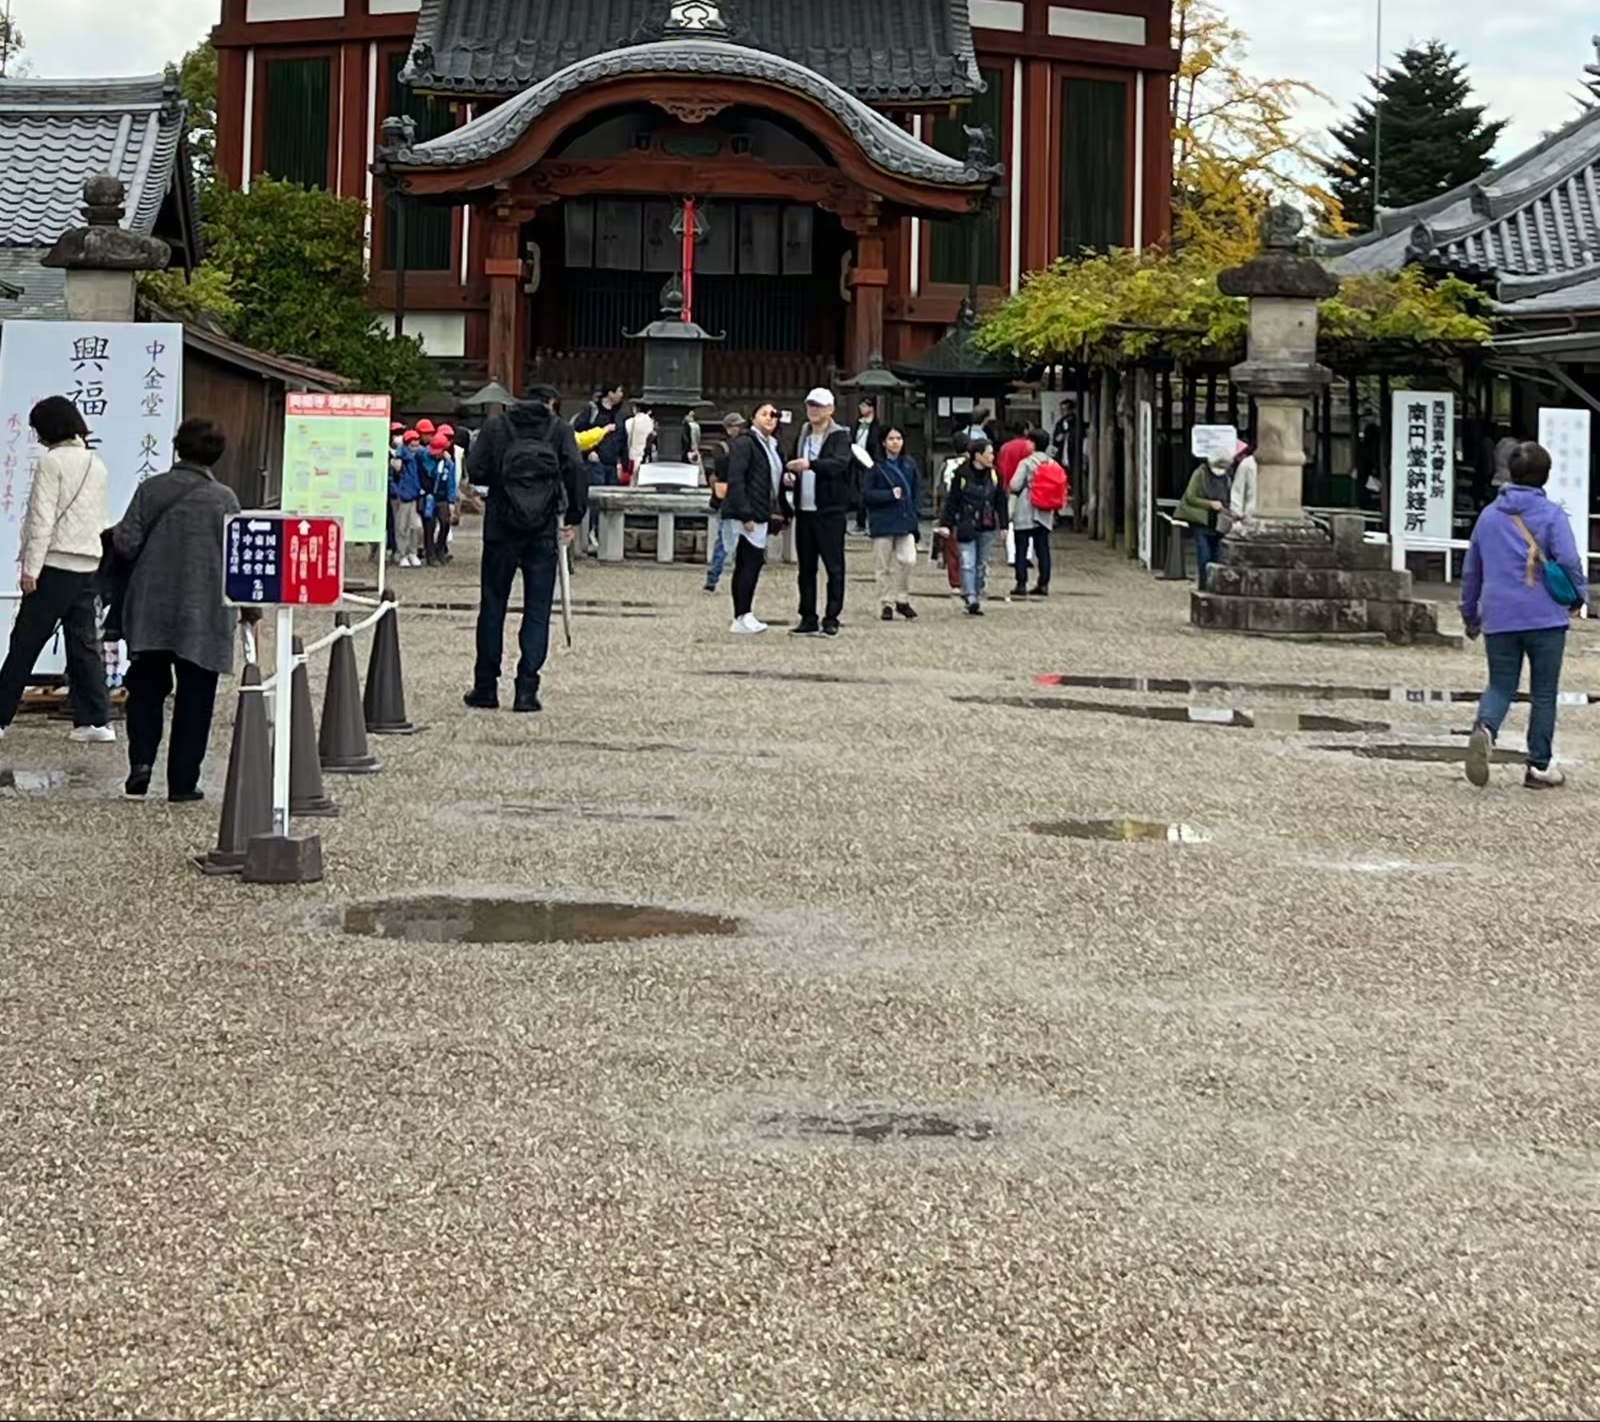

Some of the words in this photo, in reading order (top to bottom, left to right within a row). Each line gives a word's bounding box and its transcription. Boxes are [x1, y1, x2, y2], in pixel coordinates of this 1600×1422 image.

[66, 336, 110, 450] 興福
[141, 340, 166, 417] 中金堂
